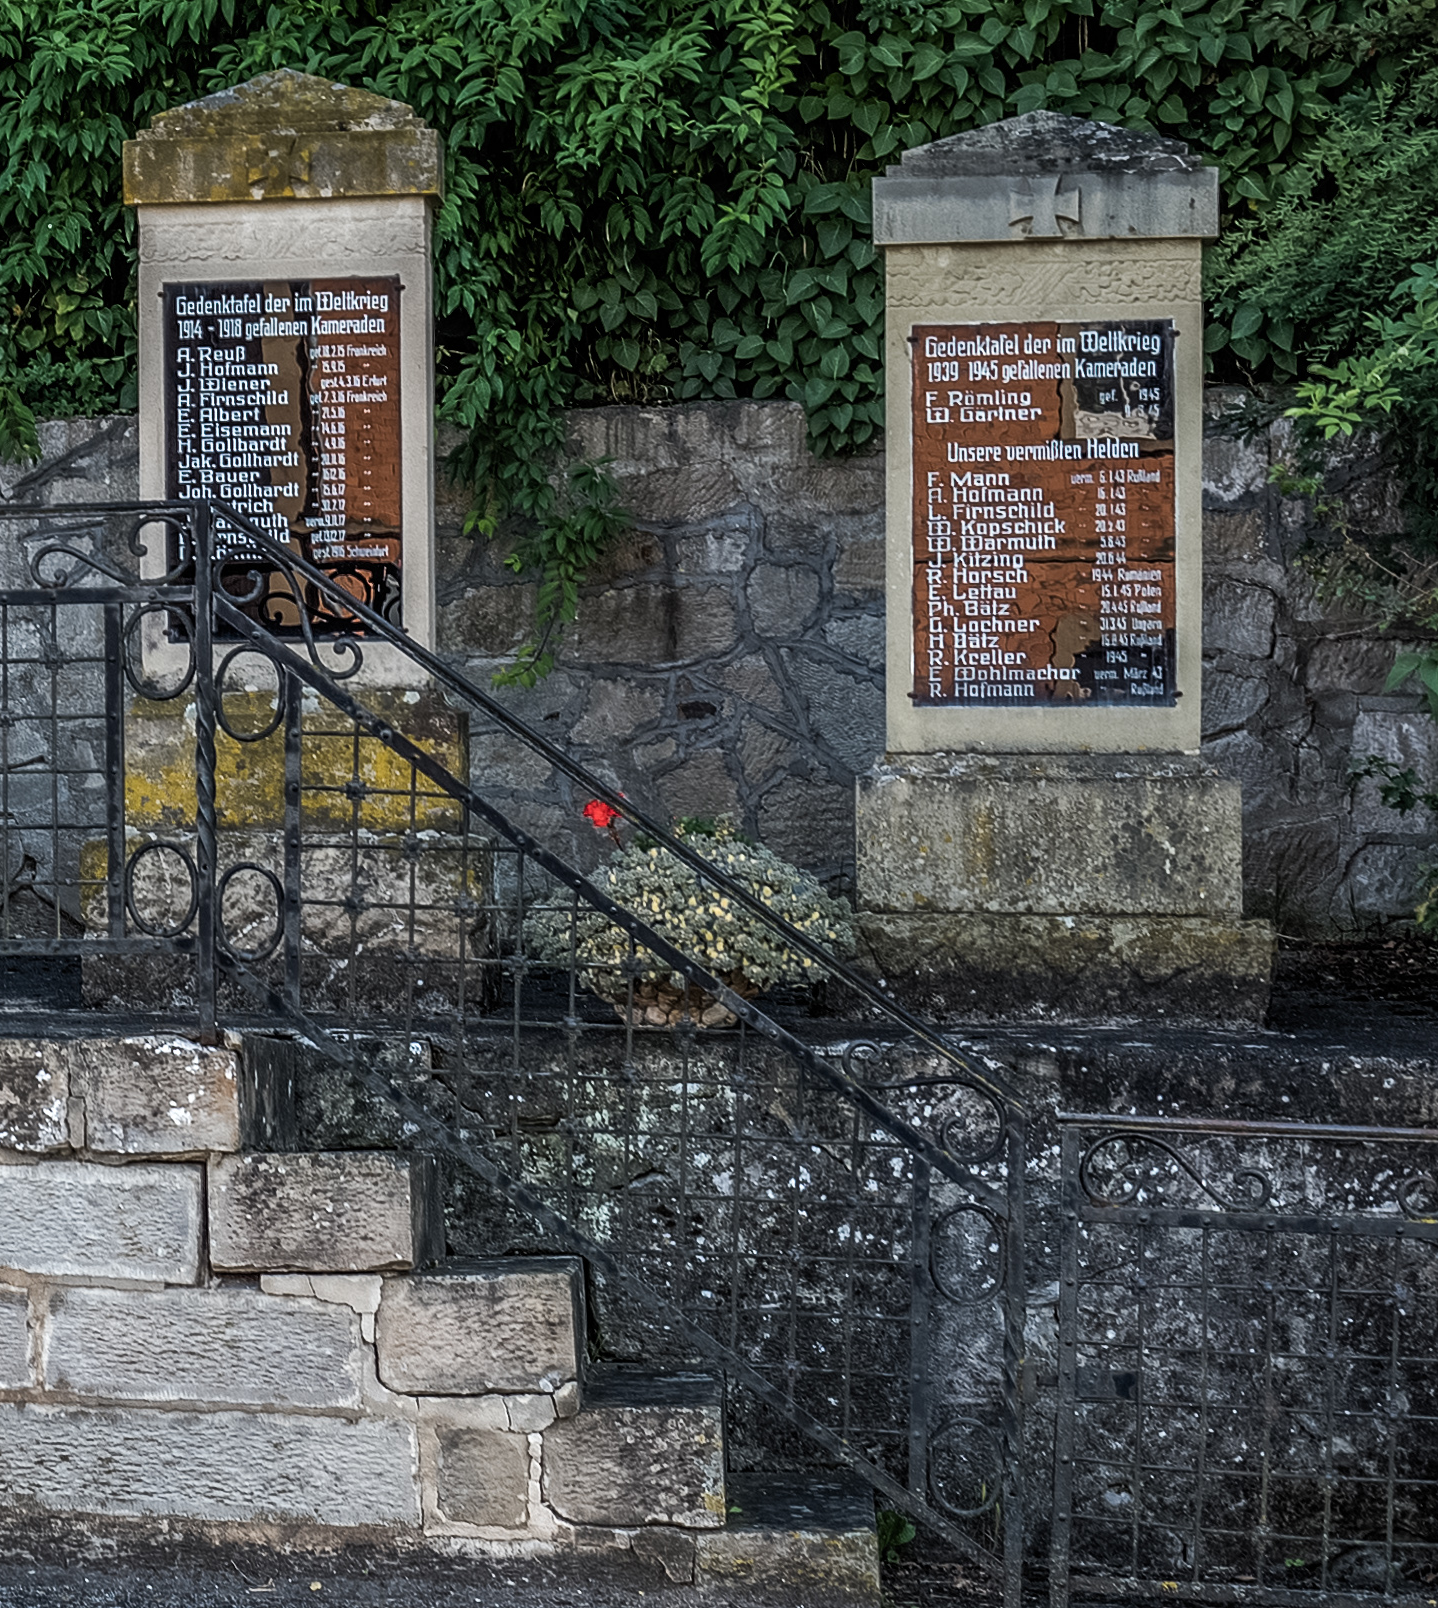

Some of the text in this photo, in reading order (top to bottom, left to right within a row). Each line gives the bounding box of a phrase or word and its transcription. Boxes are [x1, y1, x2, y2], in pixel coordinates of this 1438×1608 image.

[176, 291, 389, 316] Gedenktafel der im Weltkrieg
[178, 314, 385, 340] 1914 1918 gefallenen Kameraden
[925, 331, 1161, 358] Gedenktafel der im Weltkrieg
[177, 348, 195, 363] A.
[197, 346, 246, 363] Reuß
[177, 362, 278, 377] J. Hofmann
[927, 358, 1156, 383] 1939 1945 gefallenen Kameraden
[177, 378, 195, 392] J.
[198, 377, 271, 392] Wiener
[177, 393, 196, 408] A.
[199, 391, 288, 406] Firnschild
[948, 390, 1031, 406] Römling
[1139, 388, 1160, 400] 1945
[178, 407, 260, 423] E. Albert
[960, 406, 1042, 422] Gärtner
[178, 423, 292, 439] E. Eisemann
[178, 439, 196, 454] H.
[948, 442, 1001, 462] Unsere
[1005, 440, 1081, 462] vermißten
[178, 452, 299, 469] Jak. Gollhardt
[178, 470, 260, 484] E. Bauer
[927, 472, 1009, 487] F. Mann
[178, 482, 299, 499] Joh. Gollhardt
[928, 487, 1043, 503] A. Hofmann
[928, 502, 1055, 521] L. Firnschild
[927, 518, 1066, 536] W. Kopschick
[927, 535, 1056, 552] W. Warmuth
[928, 551, 1023, 568] J. Kitzing
[926, 569, 947, 584] R.
[953, 568, 1027, 583] Horsch
[1092, 569, 1113, 581] 1944
[929, 584, 1162, 601] E. Lettau Polen
[929, 602, 959, 617] Ph.
[964, 600, 1010, 616] Bätz
[954, 616, 1040, 633] Lochner
[927, 650, 949, 666] R.
[1106, 651, 1128, 663] 1945
[929, 682, 1034, 698] R. Hofmann
